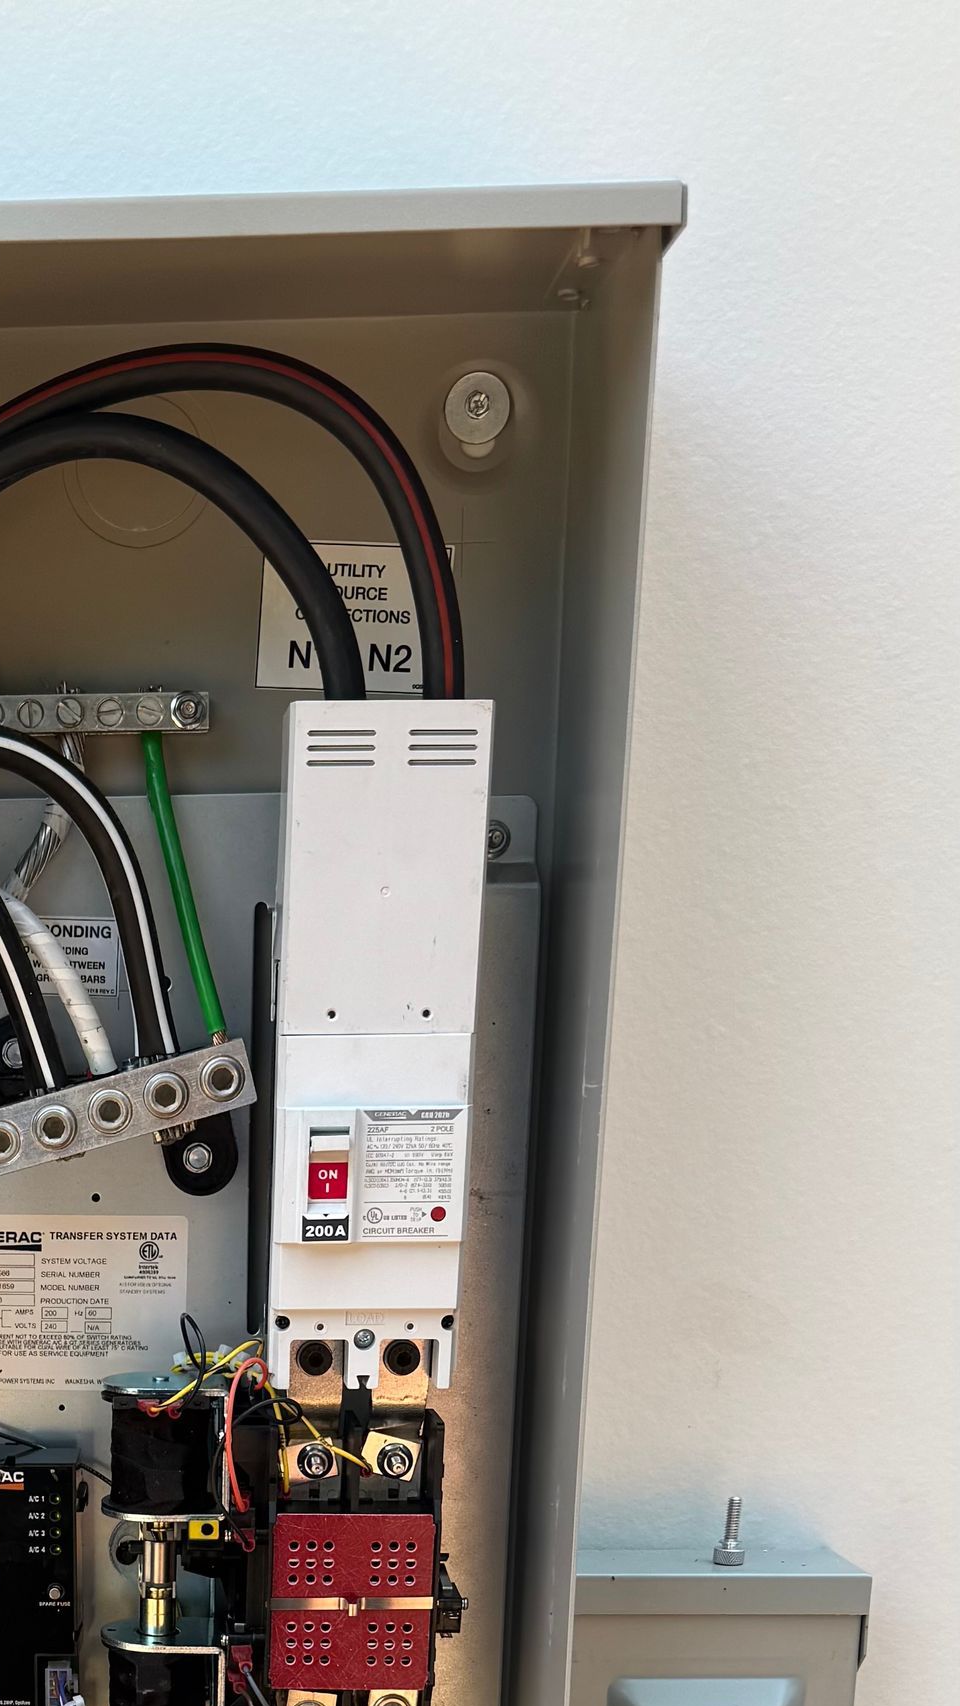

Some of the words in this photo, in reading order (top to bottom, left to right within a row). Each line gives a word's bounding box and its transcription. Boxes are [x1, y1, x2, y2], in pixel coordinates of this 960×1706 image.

[327, 563, 386, 578] UTILITY
[288, 640, 312, 669] N
[368, 643, 412, 673] N2
[47, 924, 112, 939] ONDING
[70, 960, 106, 970] TWEEN
[81, 974, 106, 984] BARS
[318, 1169, 338, 1180] ON
[50, 1231, 103, 1240] TRANSFER
[106, 1232, 148, 1241] SYSTEM
[150, 1232, 177, 1241] DATA
[305, 1225, 346, 1238] 200A
